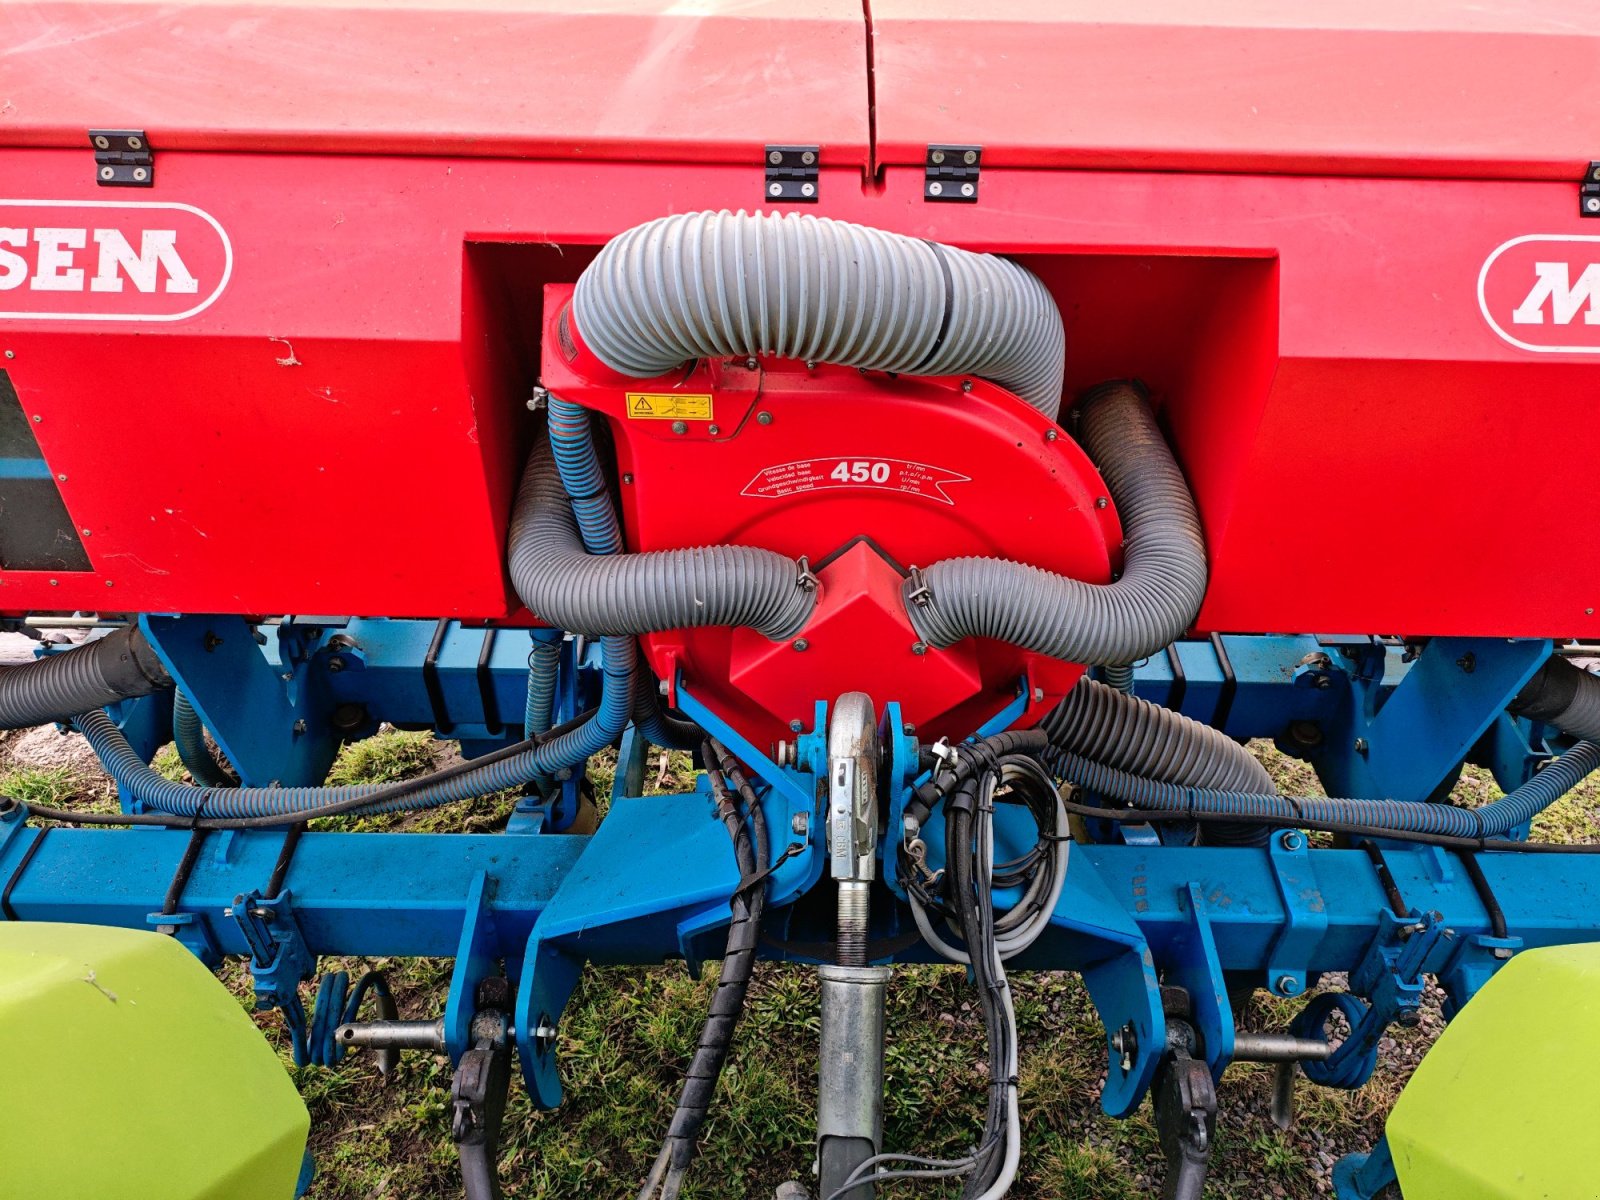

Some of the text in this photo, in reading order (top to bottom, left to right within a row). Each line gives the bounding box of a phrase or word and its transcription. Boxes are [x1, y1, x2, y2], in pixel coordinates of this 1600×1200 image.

[763, 467, 786, 476] Vitesse
[830, 461, 890, 483] 450
[776, 483, 814, 495] Basic speed
